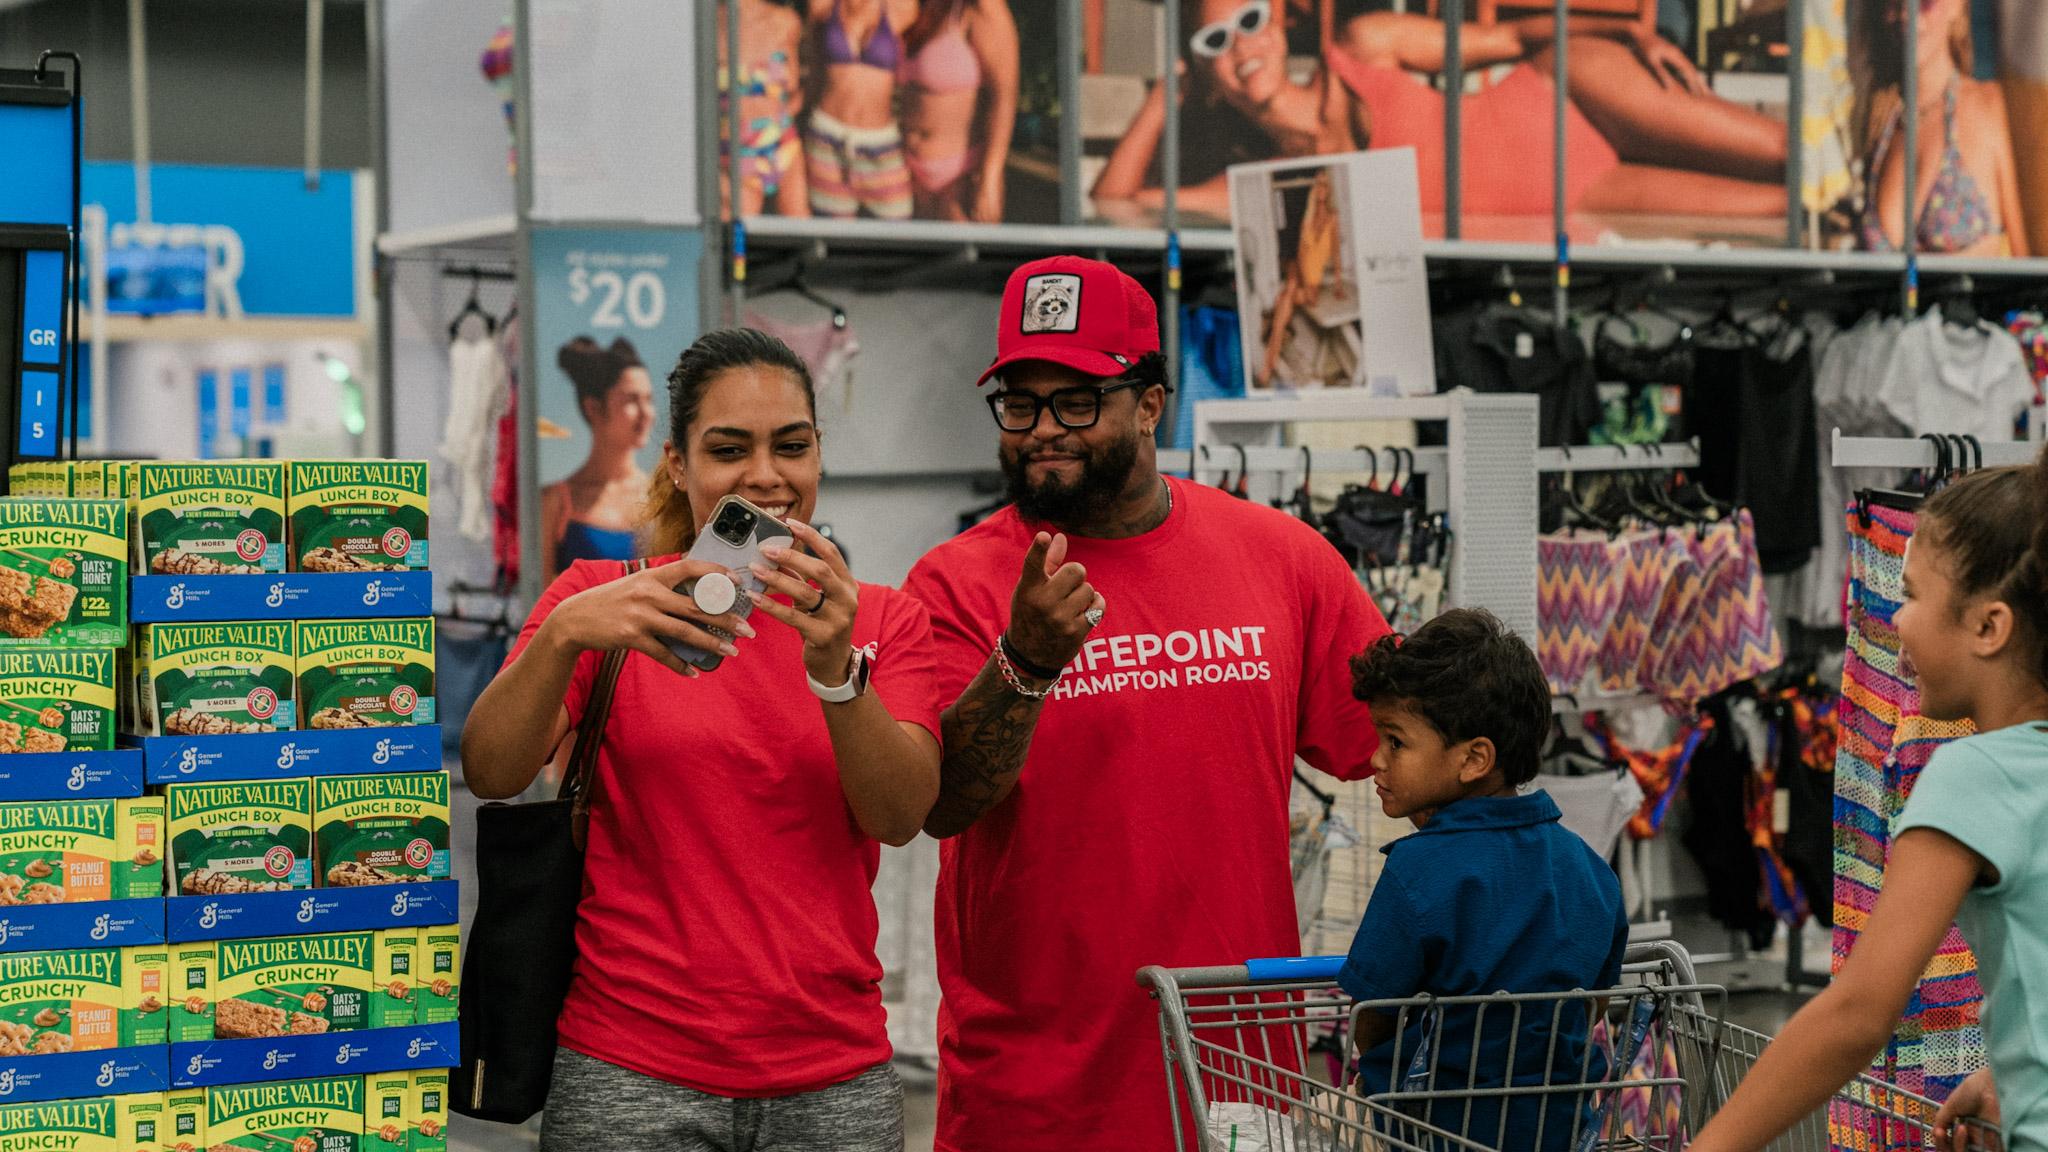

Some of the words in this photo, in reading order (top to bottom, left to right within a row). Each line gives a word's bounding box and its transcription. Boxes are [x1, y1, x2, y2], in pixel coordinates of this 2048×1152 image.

[567, 266, 668, 330] $20
[29, 329, 56, 346] GR
[145, 467, 214, 496] NATURE
[215, 466, 277, 495] VALLEY
[295, 465, 362, 493] NATURE
[363, 465, 422, 493] VALLEY
[170, 492, 219, 506] LUNCH
[225, 493, 254, 506] BOX
[320, 489, 366, 503] LUNCH
[372, 490, 400, 504] BOX
[46, 503, 121, 535] VALLEY
[0, 530, 89, 548] CRUNCHY
[82, 560, 105, 573] OATS
[82, 572, 112, 585] HONEY
[158, 627, 224, 656] NATURE
[226, 625, 288, 653] VALLEY
[302, 624, 368, 654] NATURE
[369, 623, 428, 650] VALLEY
[182, 650, 230, 666] LUNCH
[235, 651, 264, 664] BOX
[326, 648, 373, 664] LUNCH
[378, 649, 406, 662] BOX
[35, 652, 109, 685] VALLEY
[1, 681, 78, 697] RUNCHY
[1052, 668, 1178, 701] HAMPTON
[1184, 661, 1272, 686] ROADS
[70, 710, 94, 722] OATS
[70, 722, 101, 734] HONEY
[320, 778, 386, 808] NATURE
[386, 776, 444, 804] VALLEY
[175, 786, 243, 818] NATURE
[244, 784, 306, 811] VALLEY
[344, 802, 390, 818] LUNCH
[394, 802, 422, 815] BOX
[37, 804, 110, 836] VALLEY
[200, 810, 248, 827] LUNCH
[253, 811, 282, 823] BOX
[0, 834, 80, 851] RUNCHY
[224, 858, 255, 866] S'MORES
[365, 856, 402, 864] CHOCOLATE
[371, 850, 396, 858] DOUBLE
[70, 862, 105, 874] PEANUT
[70, 874, 104, 888] BUTTER
[110, 924, 125, 932] Mills
[223, 942, 298, 977] NATURE
[299, 938, 368, 968] VALLEY
[46, 952, 117, 984] VALLEY
[254, 967, 340, 987] CRUNCHY
[0, 983, 87, 1003] CRUNCHY
[332, 992, 354, 1005] OATS
[78, 1009, 112, 1023] PEANUT
[332, 1004, 361, 1017] HONEY
[78, 1022, 111, 1036] BUTTER
[115, 1064, 140, 1072] General
[213, 1086, 288, 1122] NATURE
[289, 1080, 358, 1116] VALLEY
[38, 1102, 112, 1135] VALLEY
[245, 1112, 330, 1131] CRUNCHY
[2, 1135, 80, 1151] RUNCHY
[322, 1136, 344, 1148] OATS
